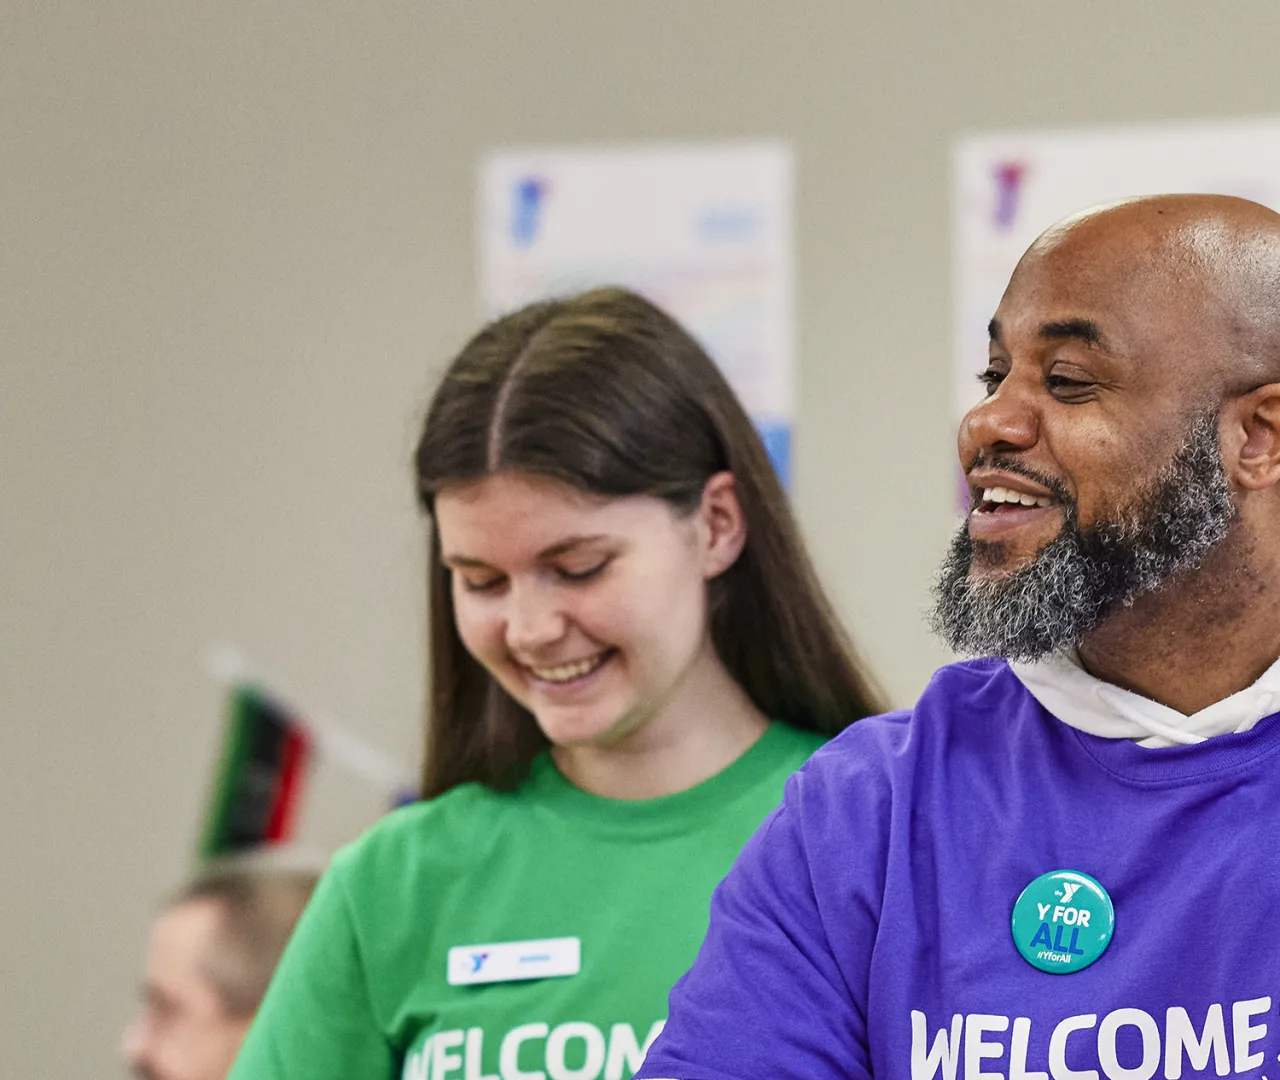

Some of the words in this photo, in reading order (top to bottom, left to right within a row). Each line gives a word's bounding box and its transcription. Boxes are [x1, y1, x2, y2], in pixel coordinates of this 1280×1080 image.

[1037, 902, 1051, 921] Y
[1052, 905, 1091, 928] FOR
[1029, 921, 1084, 956] ALL
